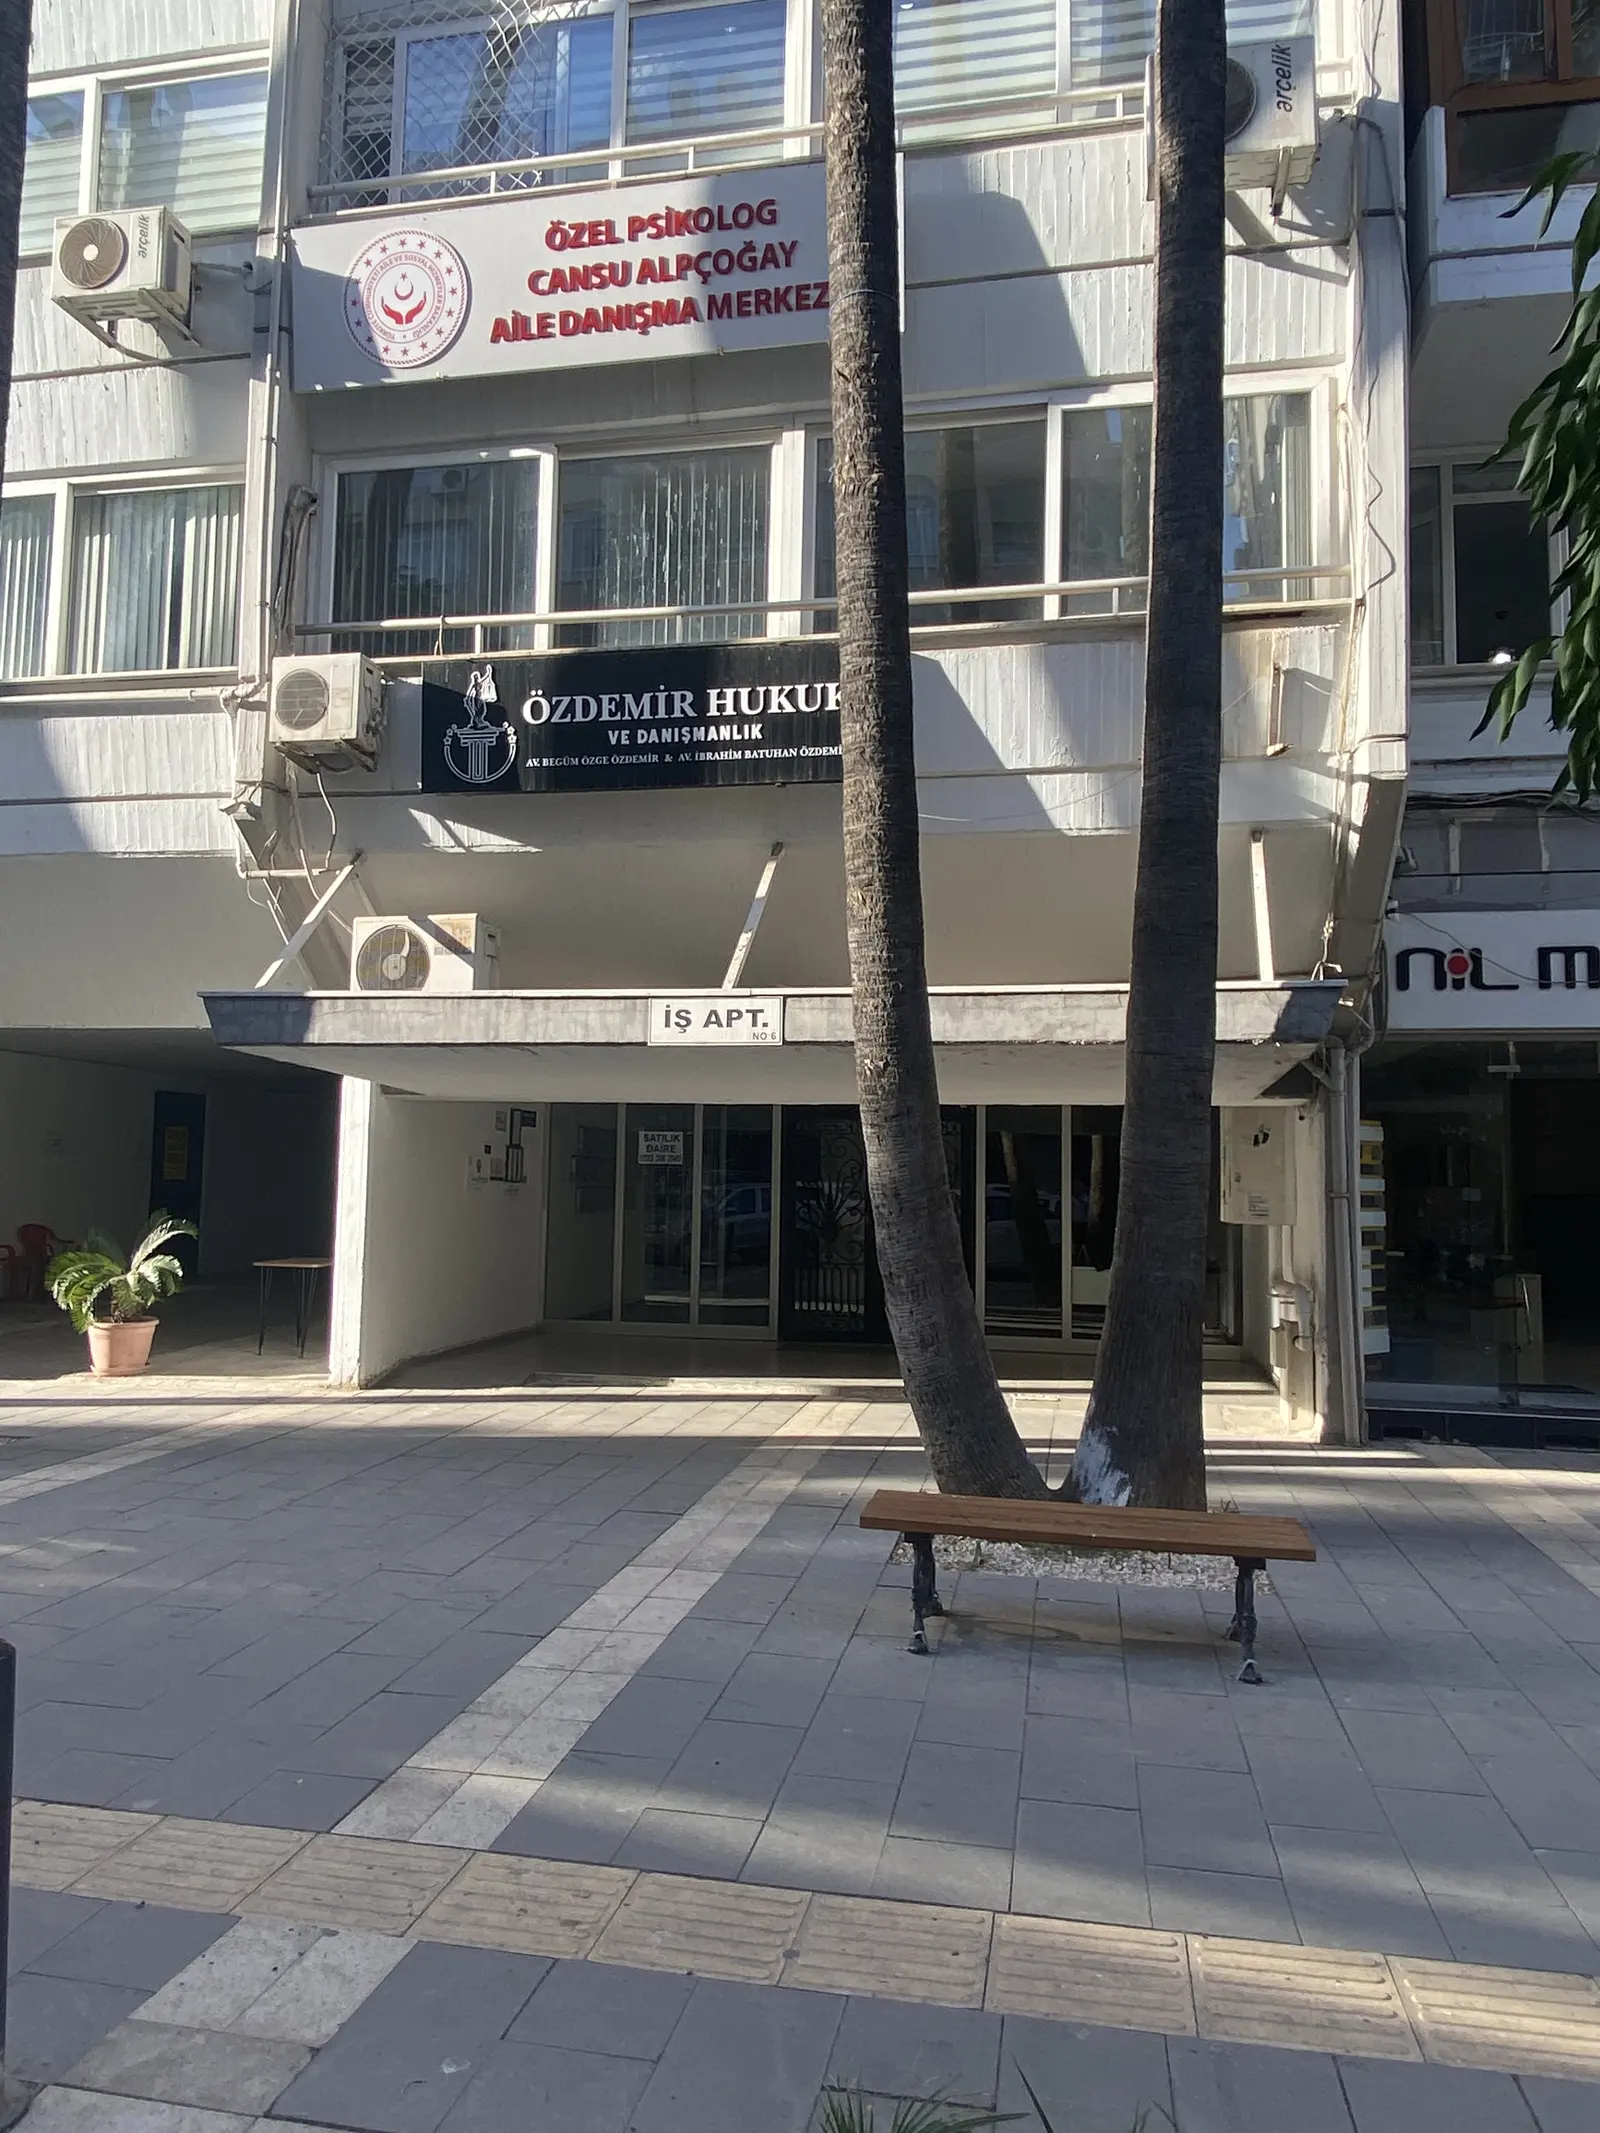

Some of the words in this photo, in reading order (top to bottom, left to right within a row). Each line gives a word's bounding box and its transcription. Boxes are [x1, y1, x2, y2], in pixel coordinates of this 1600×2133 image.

[1271, 44, 1296, 113] arçelik
[138, 214, 150, 259] arçelik
[545, 220, 624, 251] ÖZEL
[627, 199, 778, 242] PSİKOLOG
[528, 260, 630, 296] CANSU
[636, 240, 799, 284] ALPÇOĞAY
[490, 309, 557, 344] AİLE
[559, 297, 704, 335] DANIŞMA
[522, 684, 697, 725] ÖZDEMİR
[608, 730, 630, 745] VE
[637, 723, 763, 745] DANIŞMANLIK
[525, 757, 540, 768] AV.
[542, 755, 579, 767] BEGÜM
[581, 755, 609, 766] ÖZGE
[612, 752, 659, 765] ÖZDEMİR
[664, 754, 673, 763] &
[678, 752, 692, 762] AV.
[695, 748, 742, 761] İBRAHİM
[744, 747, 798, 760] BATUHAN
[664, 1004, 692, 1033] İŞ
[702, 1008, 769, 1028] APT.
